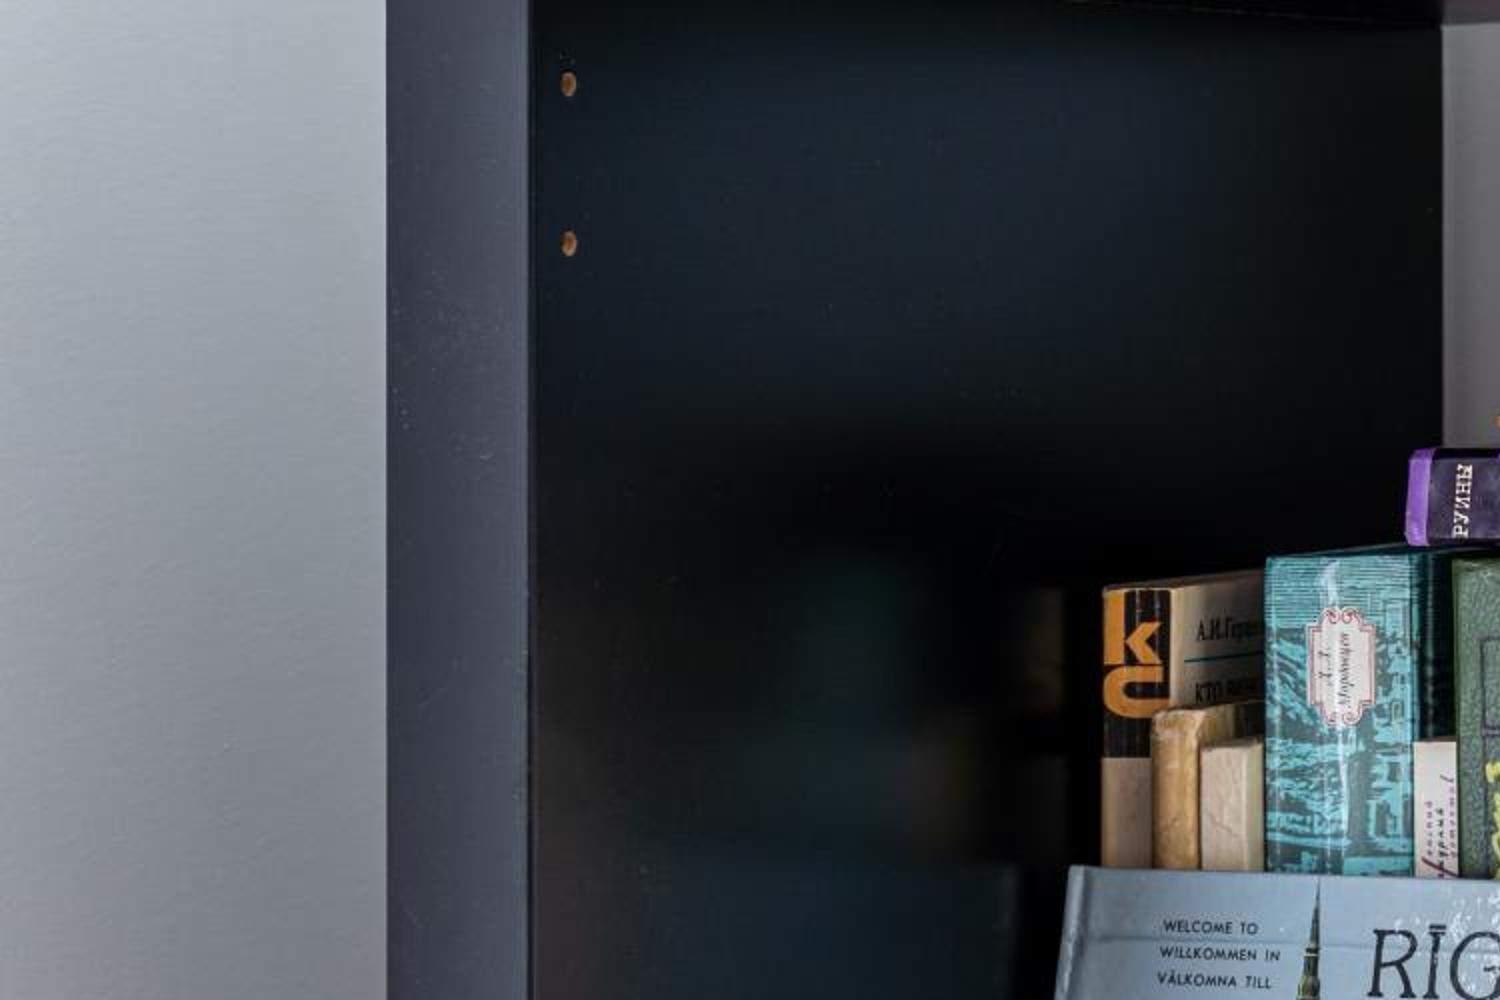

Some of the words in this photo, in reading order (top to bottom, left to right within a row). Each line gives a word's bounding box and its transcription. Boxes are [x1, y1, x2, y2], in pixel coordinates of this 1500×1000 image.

[1452, 463, 1474, 540] РУИНЫ
[1162, 918, 1234, 935] WELCOME
[1240, 921, 1260, 935] TO
[1160, 945, 1258, 961] WILLKOMMEN
[1265, 948, 1281, 961] IN
[1157, 969, 1238, 988] VÄLKOMNA
[1245, 975, 1272, 990] TILL
